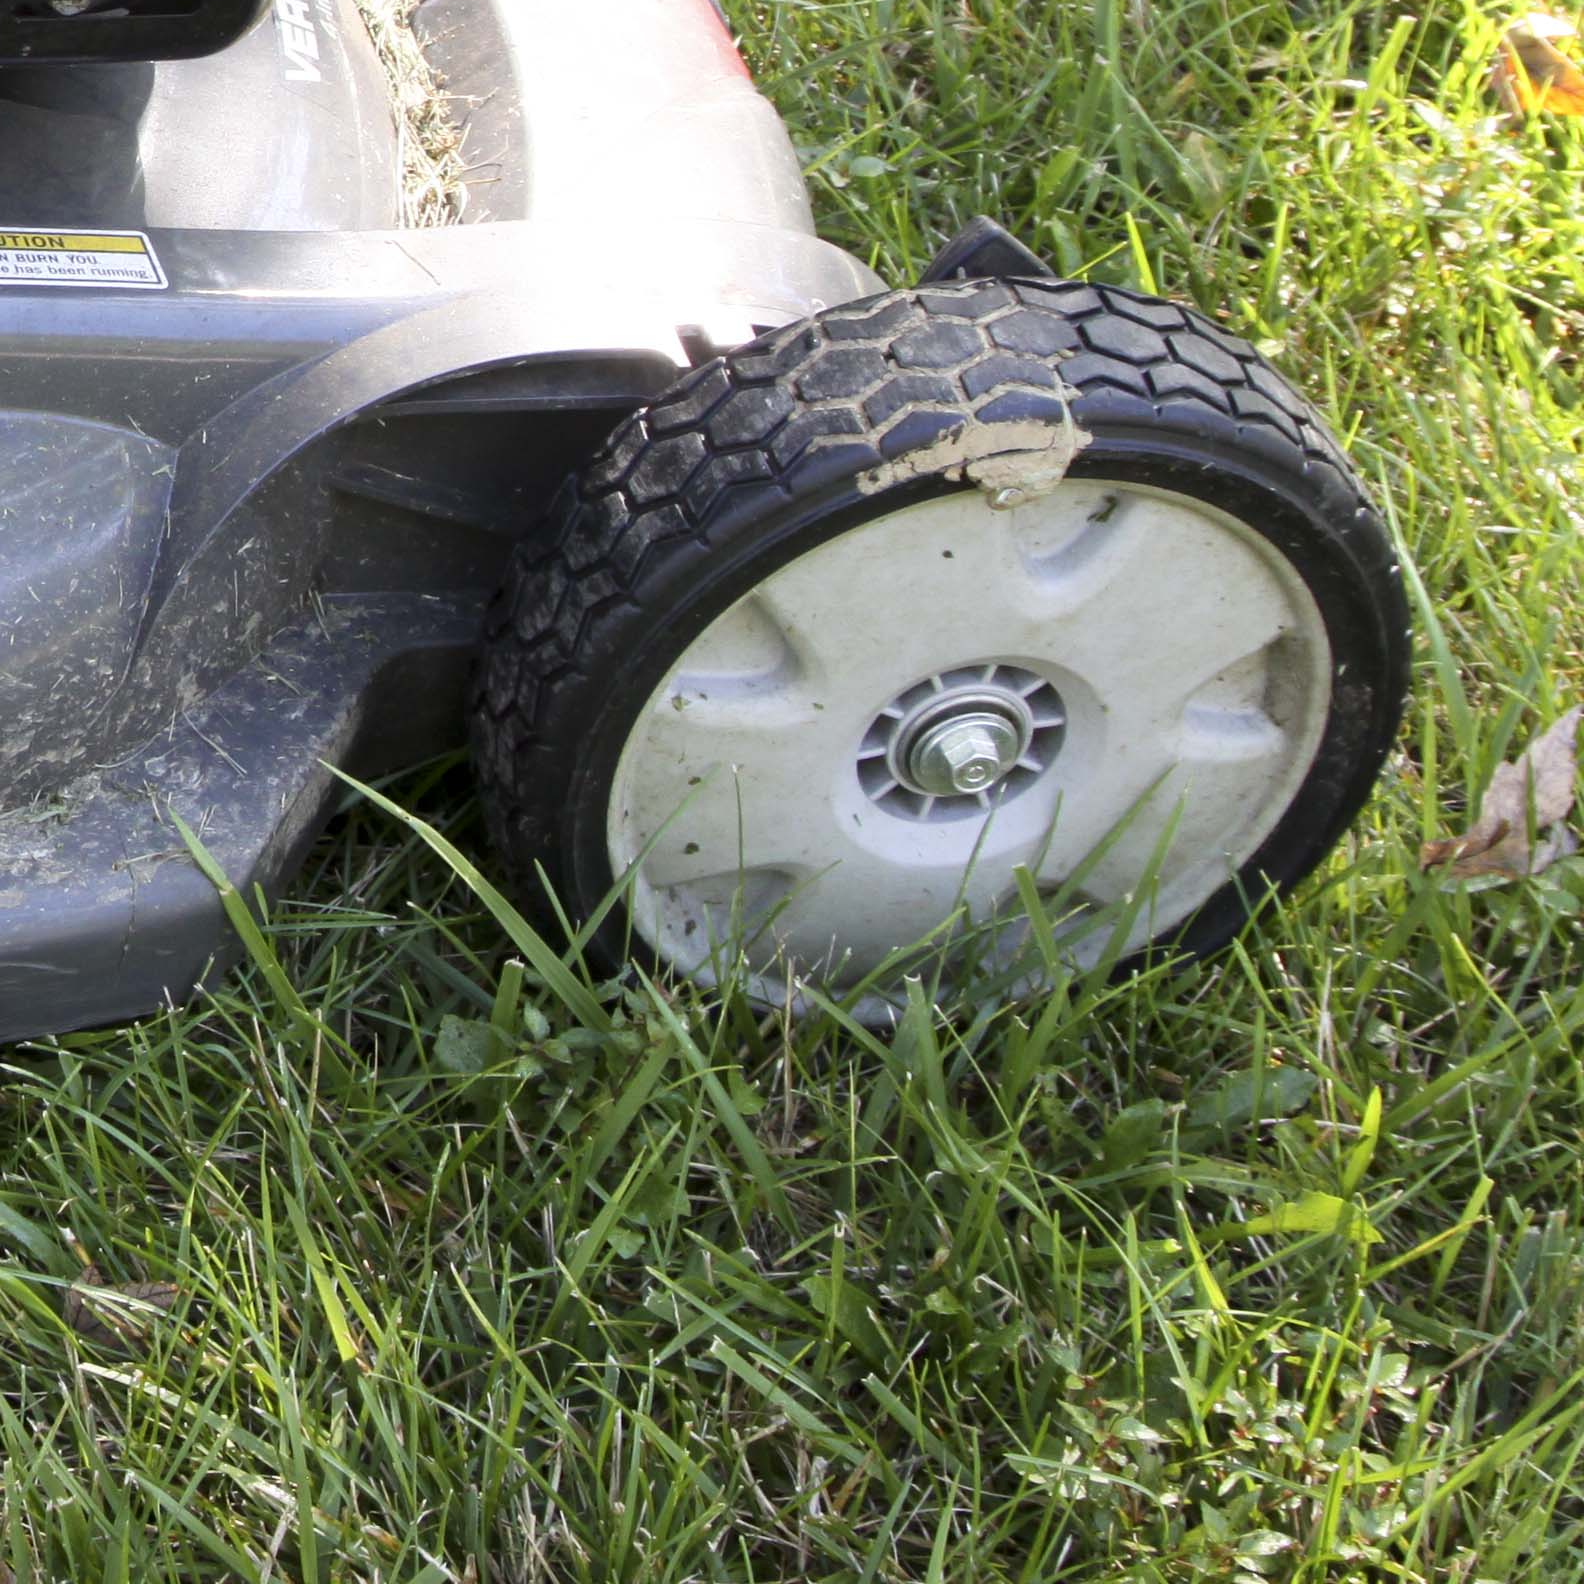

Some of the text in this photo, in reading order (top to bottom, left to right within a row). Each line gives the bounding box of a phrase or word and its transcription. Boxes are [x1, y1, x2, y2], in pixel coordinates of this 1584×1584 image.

[15, 253, 59, 264] BURN
[14, 264, 42, 274] has
[47, 265, 86, 276] been
